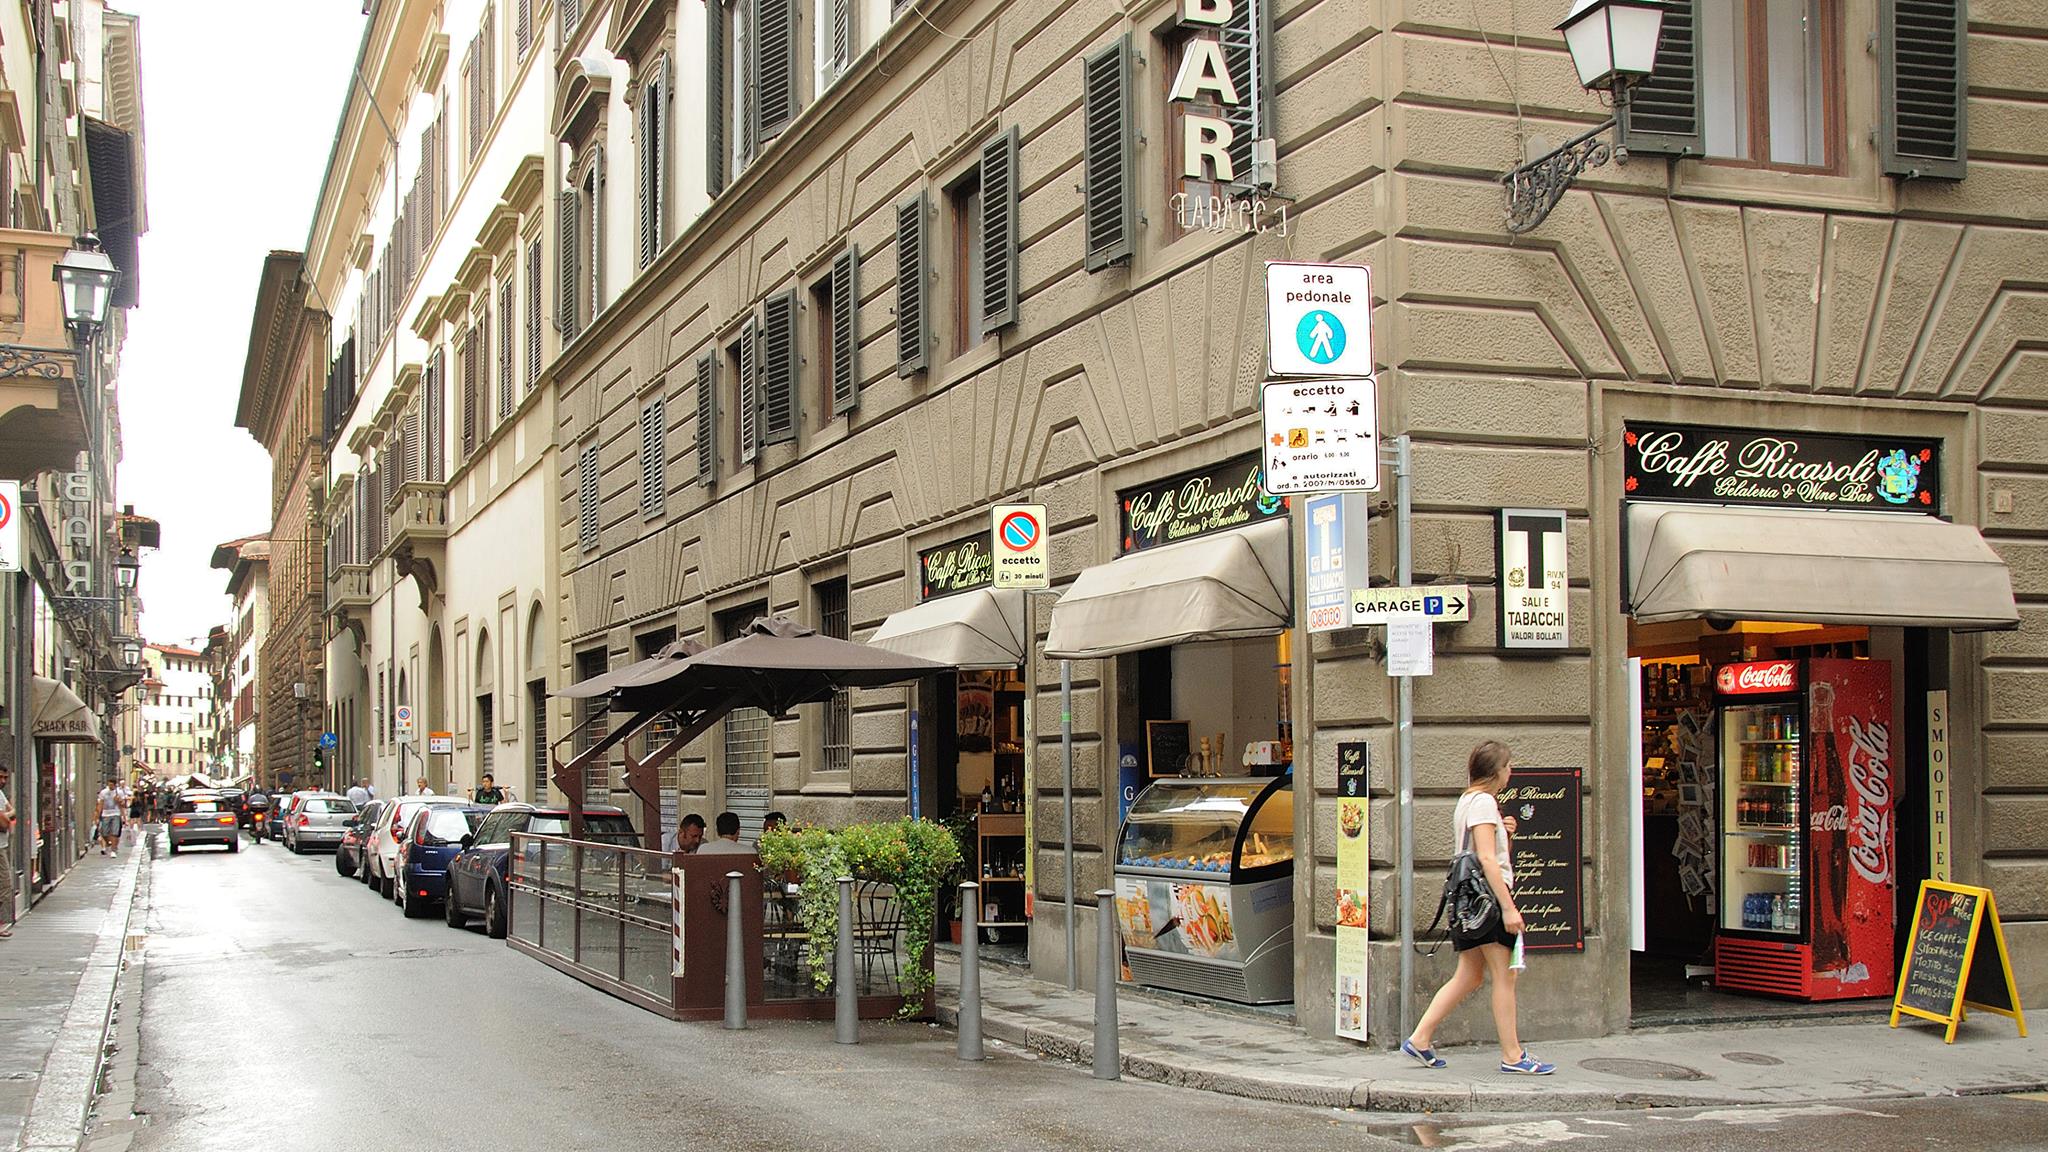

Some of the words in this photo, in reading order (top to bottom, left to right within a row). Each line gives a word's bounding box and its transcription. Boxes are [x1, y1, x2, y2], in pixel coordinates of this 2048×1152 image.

[1303, 274, 1334, 284] area
[1286, 290, 1352, 303] pedonale
[1293, 385, 1345, 397] eccetto
[1292, 453, 1318, 461] orario
[1637, 431, 1729, 487] Caffè
[1735, 437, 1880, 483] Ricasoli
[1304, 471, 1357, 480] autorizzati
[1714, 476, 1780, 499] Gelateria
[1782, 483, 1795, 497] &
[1797, 480, 1838, 503] Wine
[1838, 482, 1874, 503] Bar
[1130, 490, 1175, 539] Caffè
[1177, 465, 1258, 519] Ricasoli
[1168, 519, 1201, 539] Gelateria
[1209, 504, 1251, 529] Smoothies
[1508, 515, 1561, 589] T
[1002, 556, 1041, 565] eccetto
[928, 551, 956, 589] Caffè
[1551, 580, 1561, 590] 94
[1355, 600, 1421, 613] GARAGE
[1521, 597, 1541, 608] SALI
[1544, 598, 1549, 607] E
[1508, 611, 1564, 626] TABACCHI
[1511, 631, 1534, 640] VALORI
[1536, 631, 1562, 640] BOLLATI
[1739, 663, 1795, 689] Coca-Cola
[37, 720, 67, 732] SNACK
[69, 720, 87, 732] BAR
[1497, 787, 1518, 803] affè
[1519, 786, 1566, 799] Ricasoli
[1850, 715, 1889, 883] Coca-Cola
